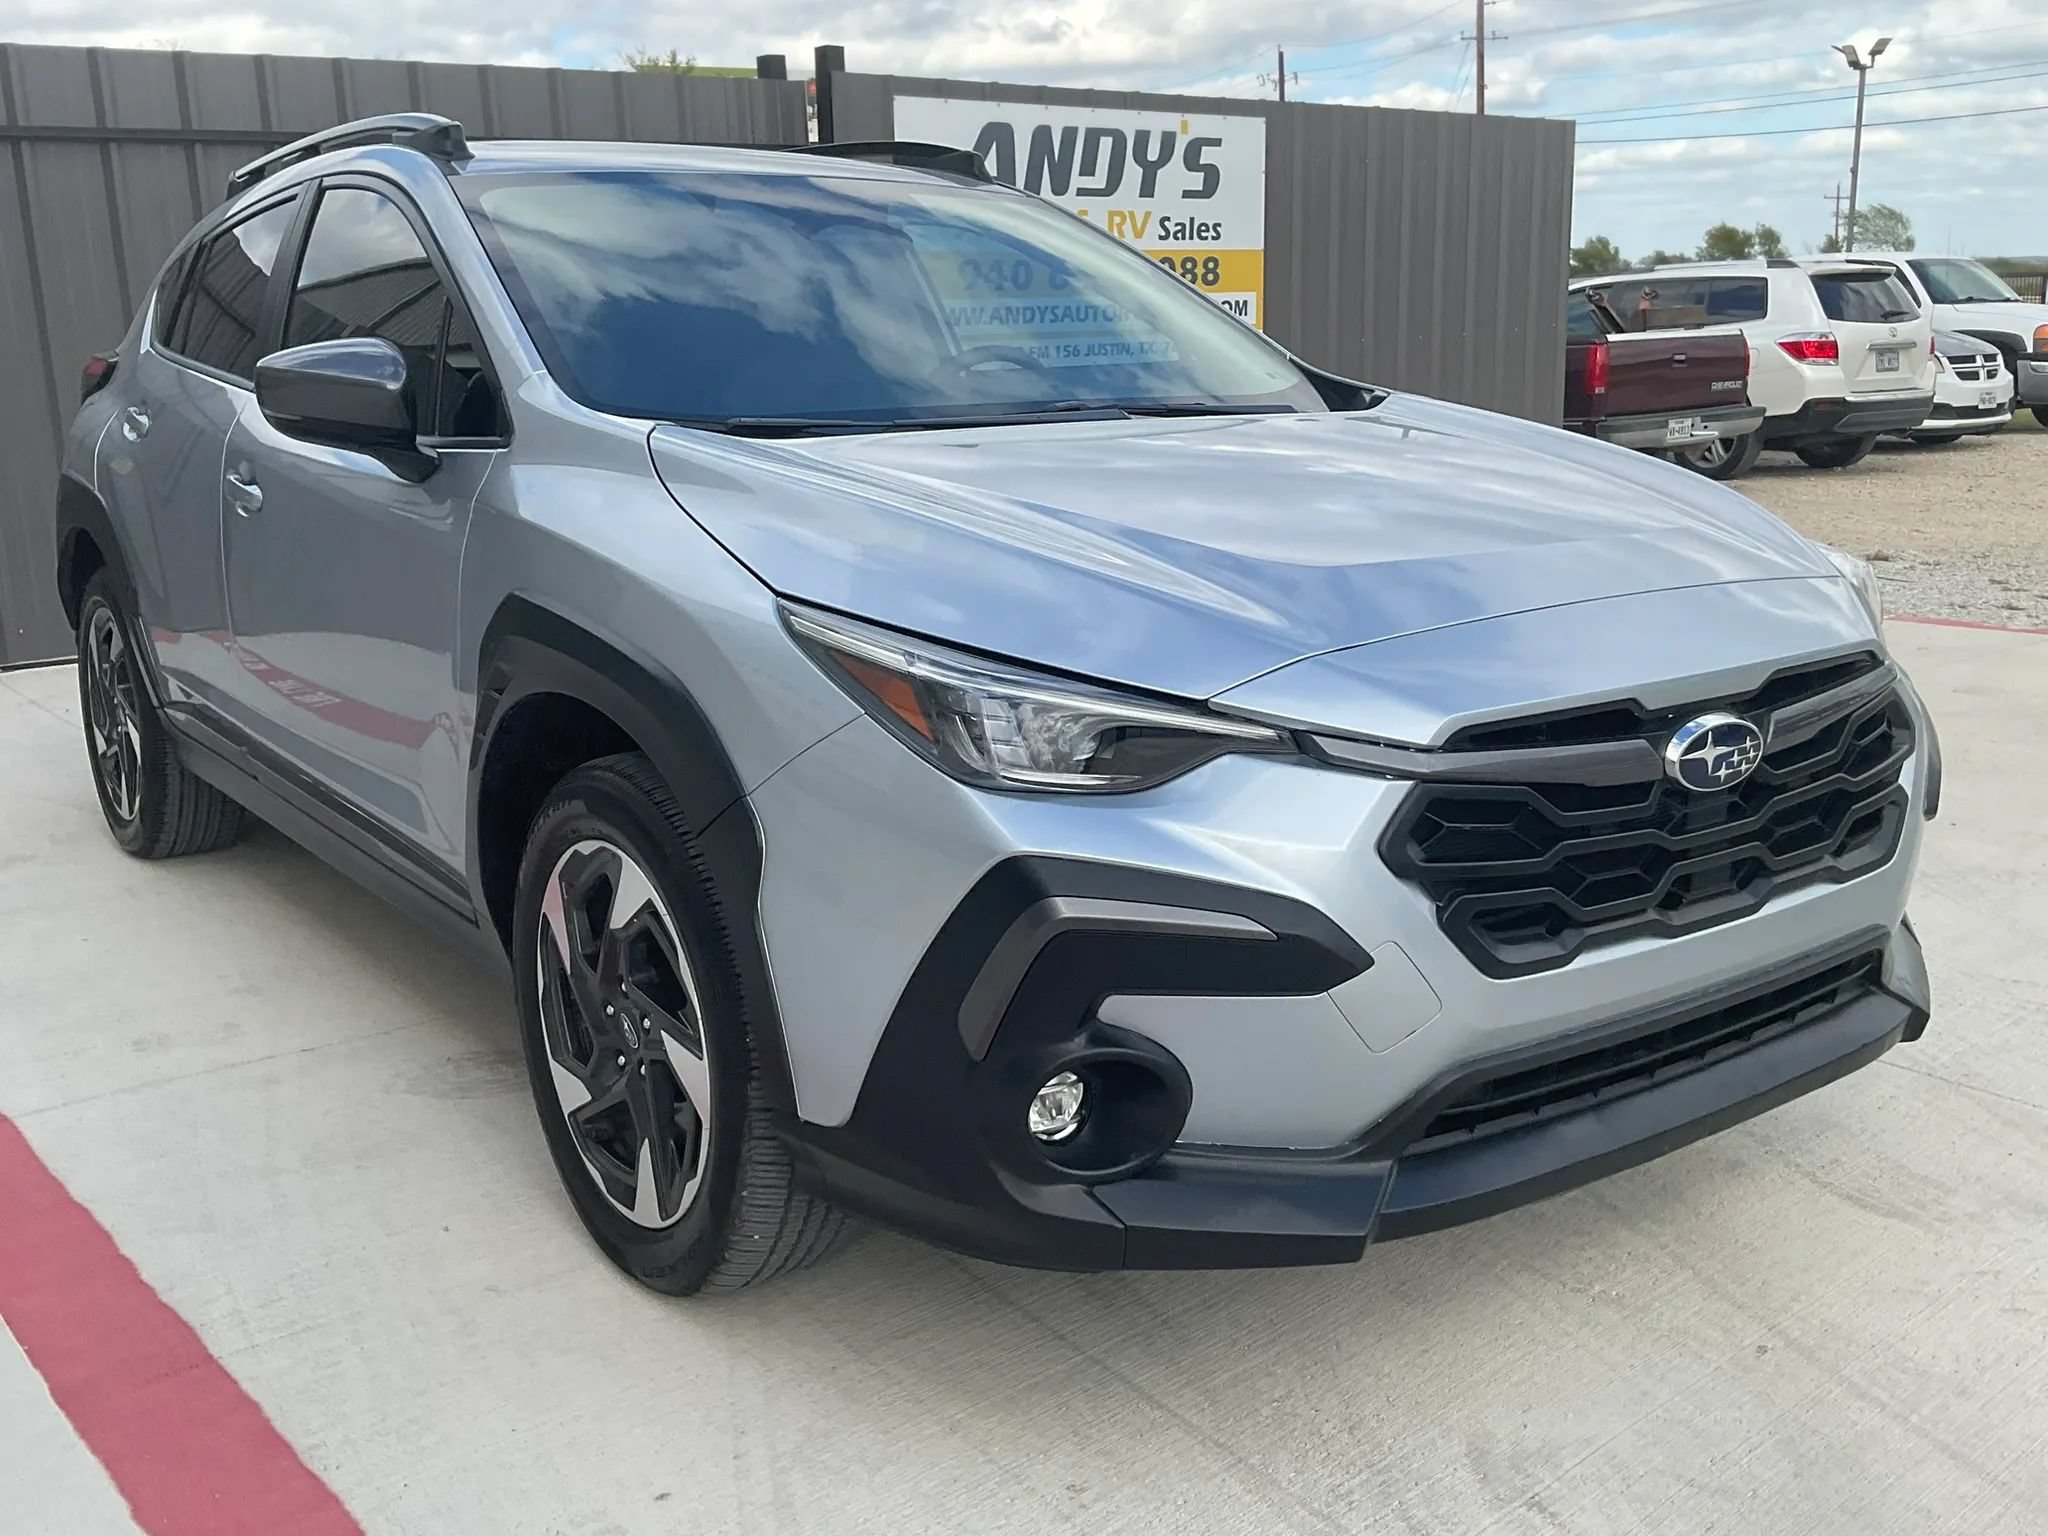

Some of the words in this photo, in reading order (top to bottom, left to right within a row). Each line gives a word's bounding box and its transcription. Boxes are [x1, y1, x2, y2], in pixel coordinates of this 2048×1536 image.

[973, 119, 1223, 200] ANDY'S
[1107, 209, 1152, 240] RV
[1158, 216, 1222, 242] Sales
[1056, 344, 1081, 359] 156
[1084, 342, 1135, 358] JUSTIN,
